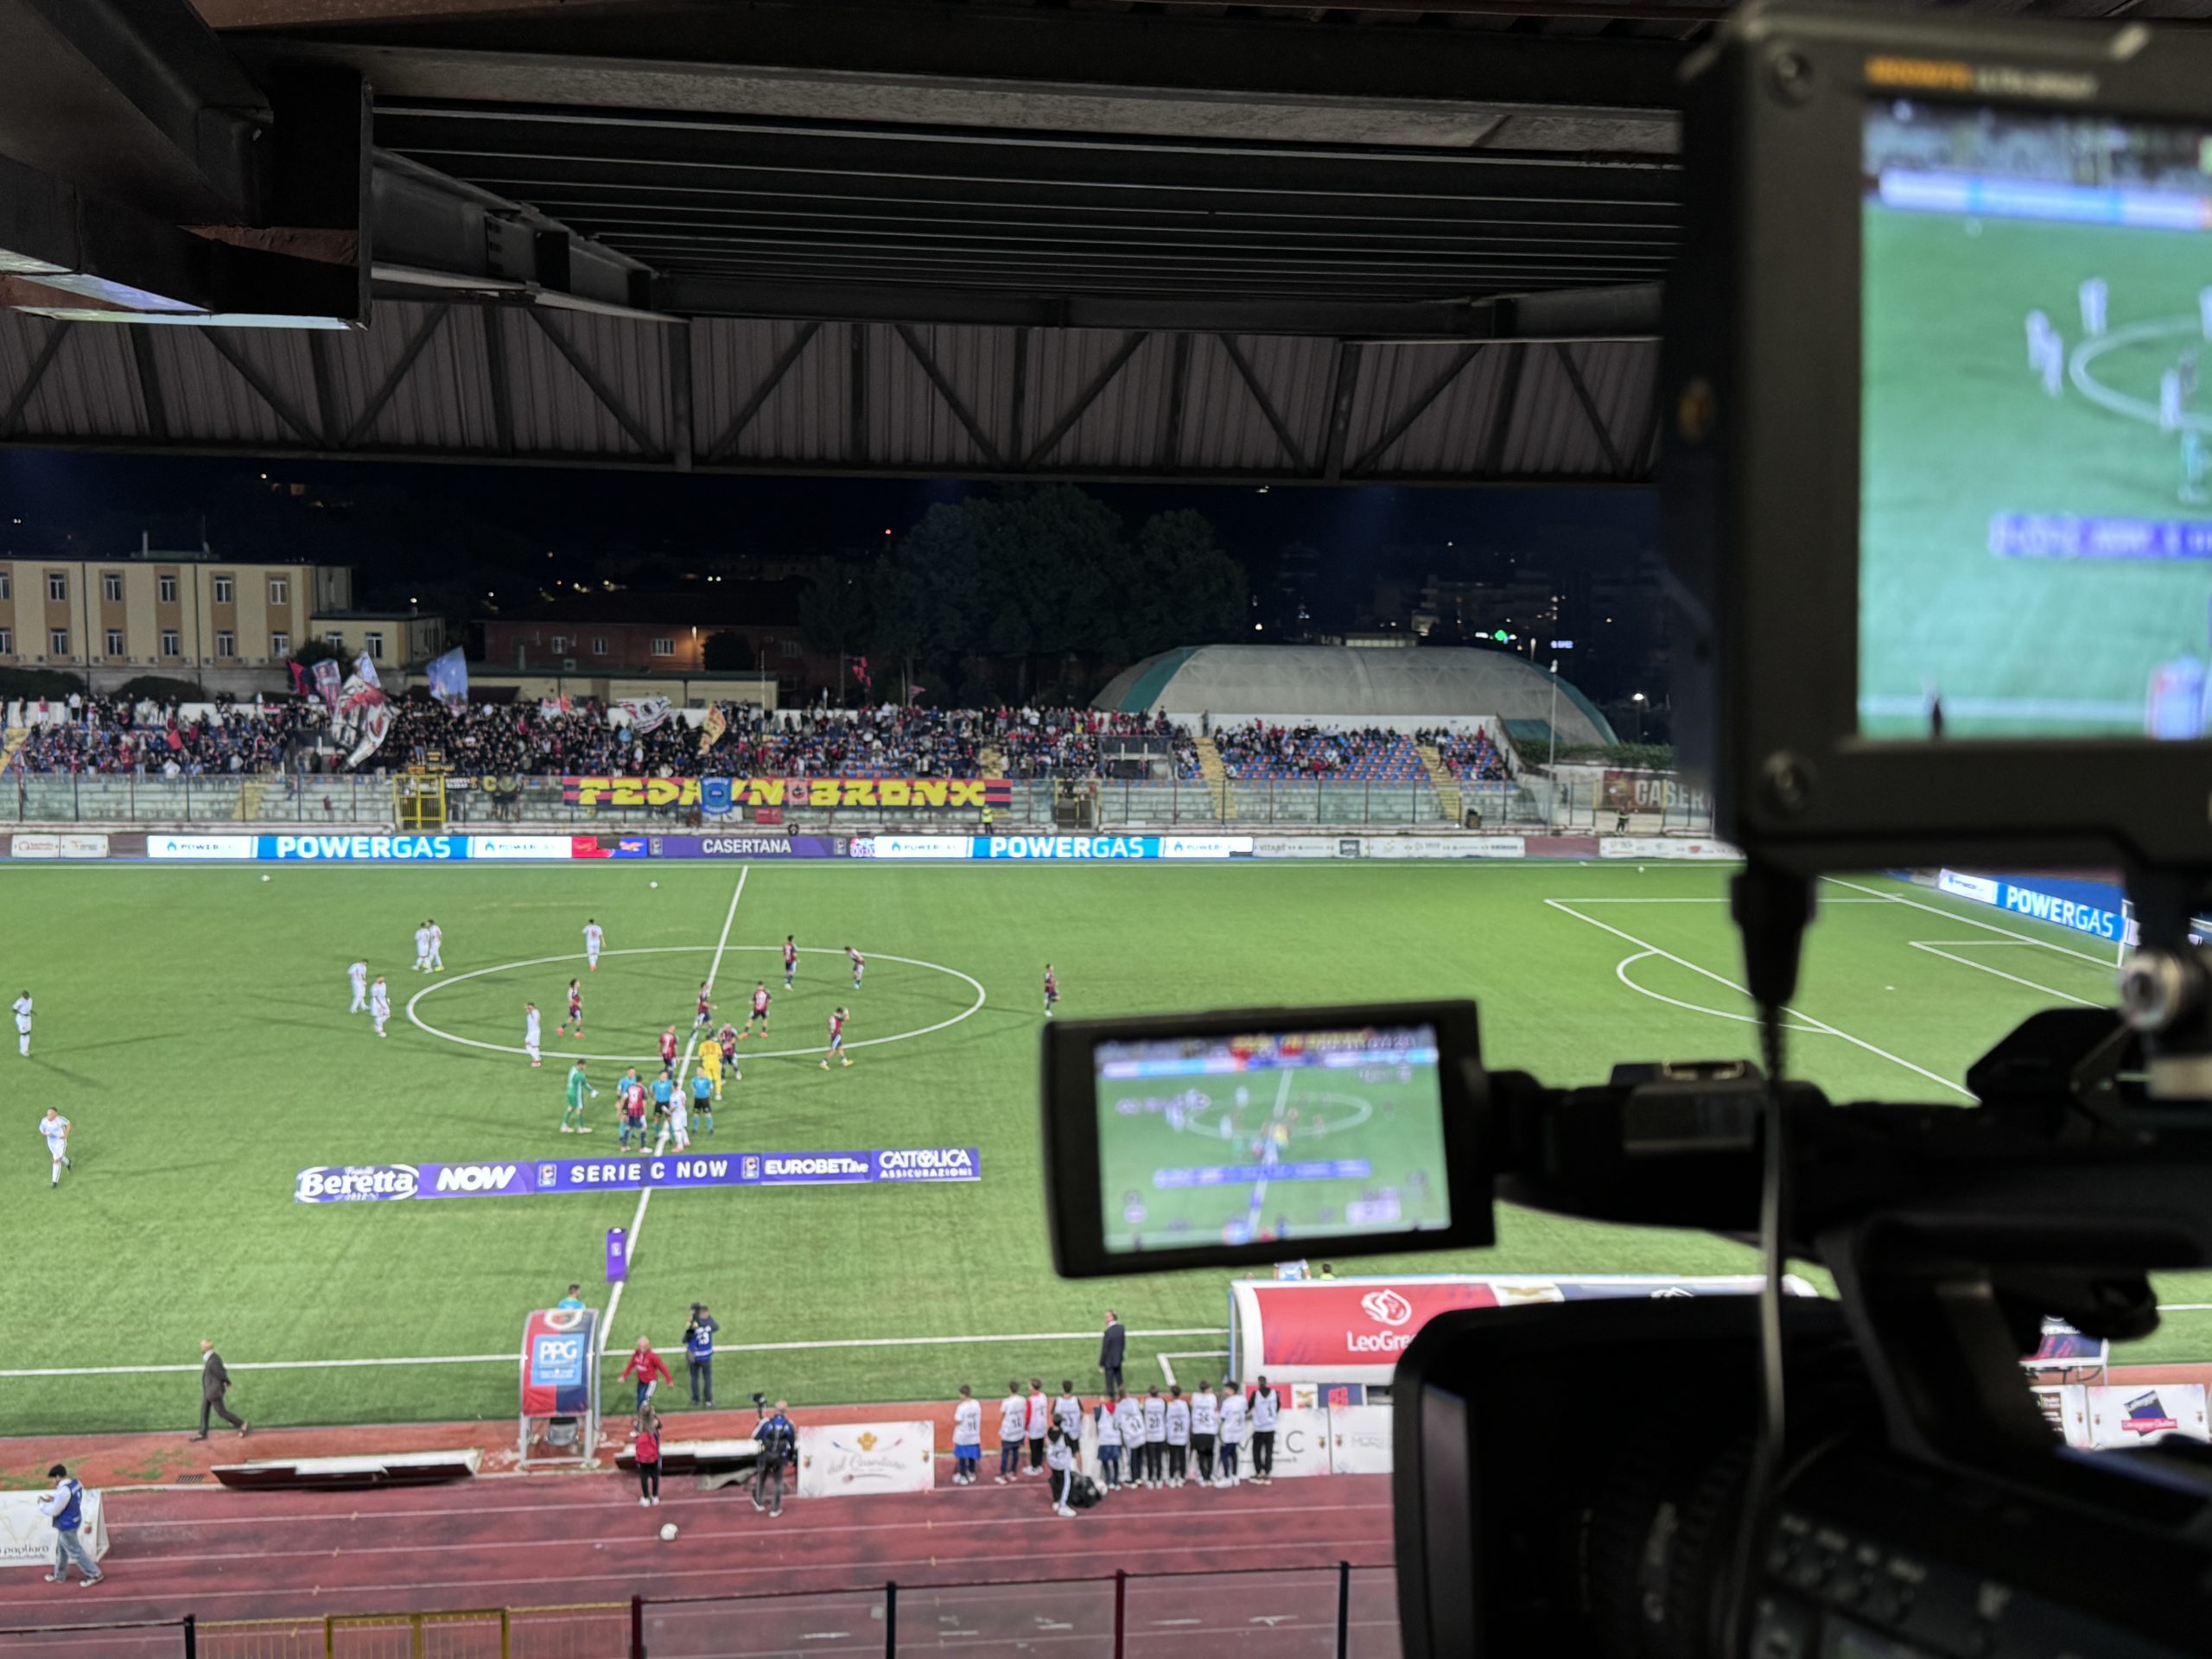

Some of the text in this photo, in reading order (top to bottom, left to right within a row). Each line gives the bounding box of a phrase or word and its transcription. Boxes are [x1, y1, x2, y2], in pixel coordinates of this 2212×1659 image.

[276, 836, 451, 858] POWERGAS
[702, 838, 791, 854] CASERTANA
[990, 836, 1144, 858] POWERGAS
[2006, 887, 2114, 938] POWERGAS
[880, 1148, 972, 1168] CATTOLICA
[436, 1165, 517, 1192] NOW
[570, 1160, 728, 1183] SERIE C NOW
[880, 1167, 972, 1179] ASSICURAZIONI
[301, 1170, 416, 1197] Beretta
[540, 1341, 577, 1359] PPG
